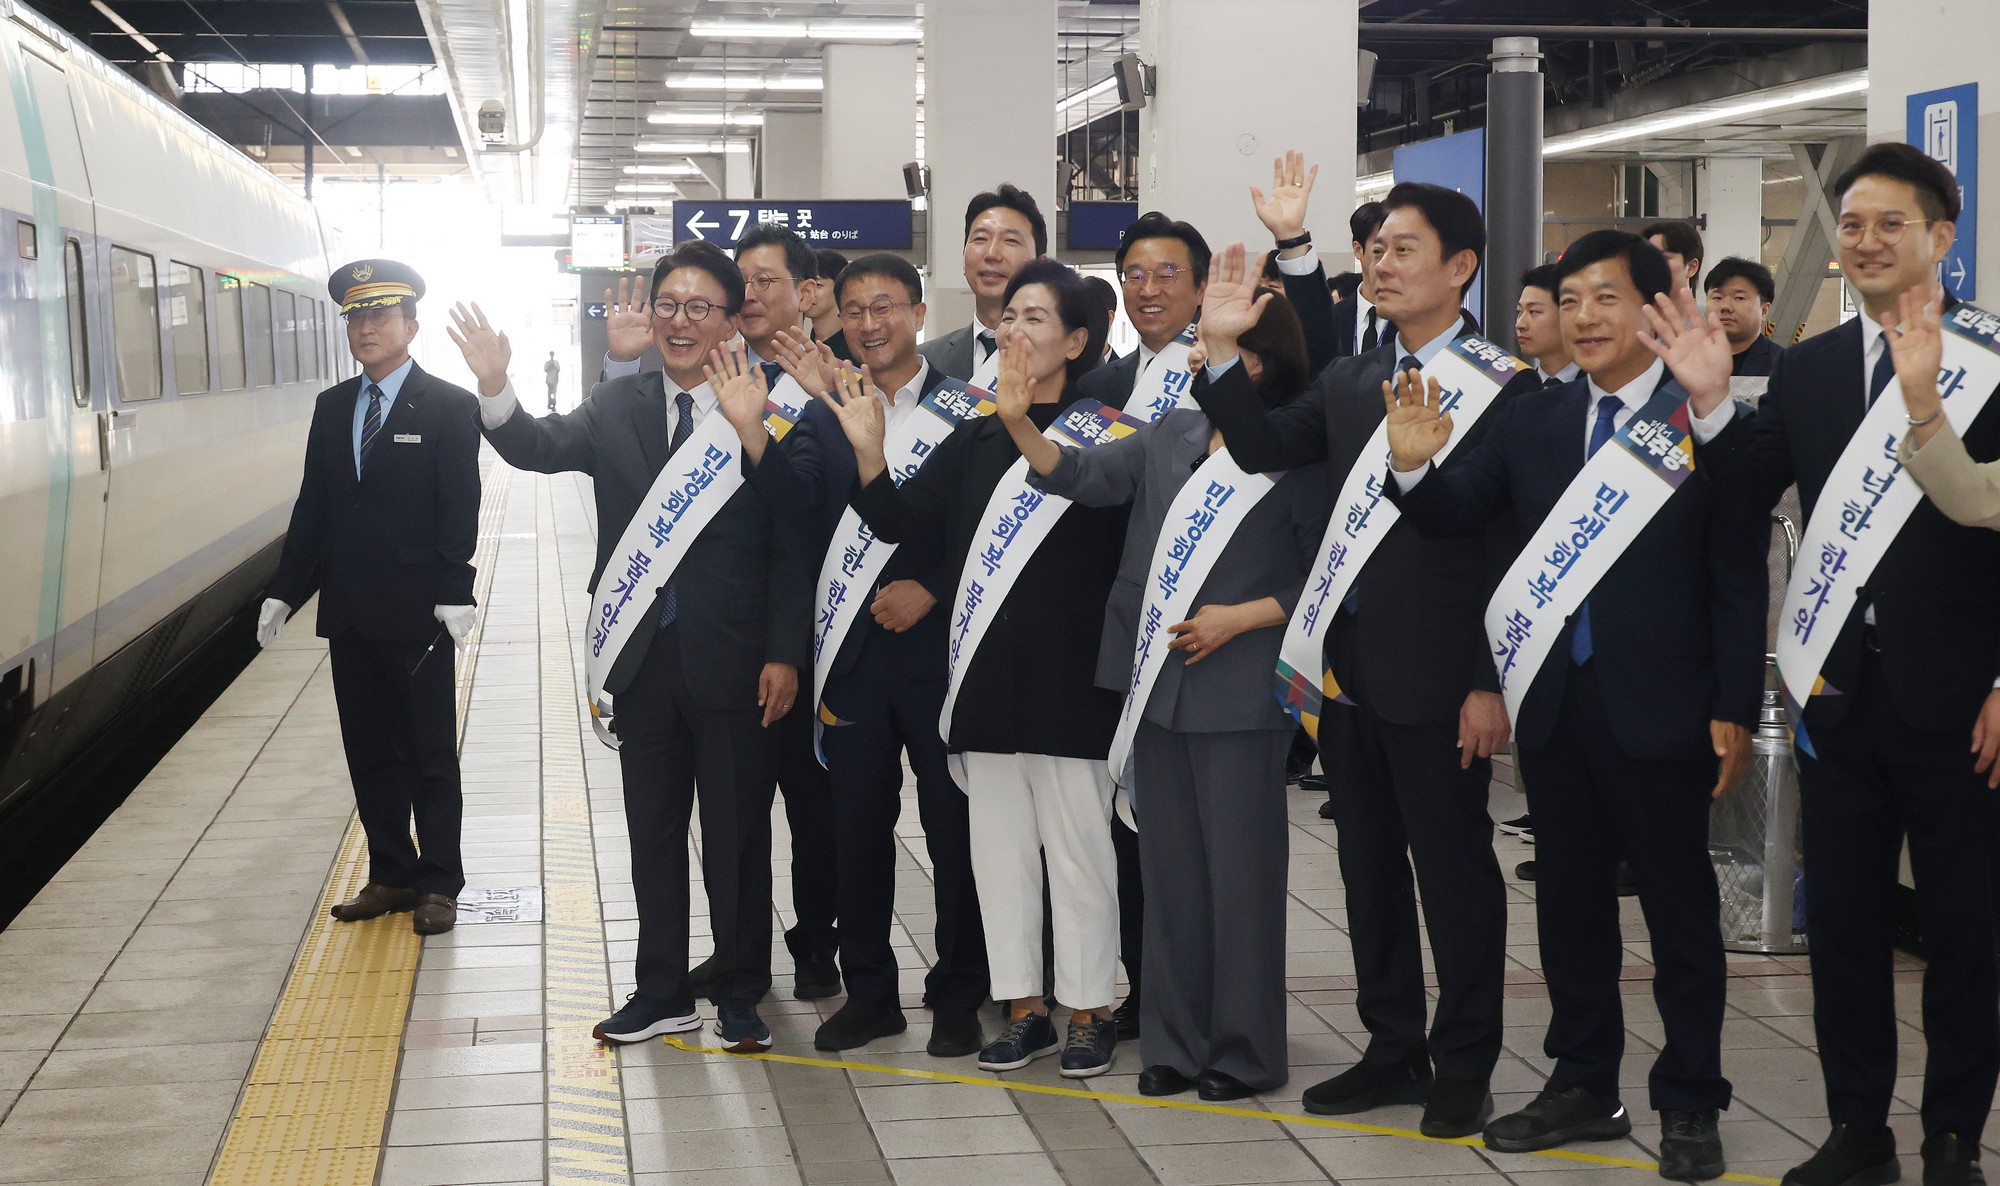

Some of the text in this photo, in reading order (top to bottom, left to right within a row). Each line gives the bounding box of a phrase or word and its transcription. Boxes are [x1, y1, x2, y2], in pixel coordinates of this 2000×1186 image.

[728, 210, 750, 241] 7
[797, 209, 813, 228] 곳
[810, 230, 829, 239] 站台
[832, 230, 859, 239] のりば
[1460, 338, 1517, 372] 민주당
[1626, 419, 1690, 472] 민주당
[592, 442, 732, 658] 민생회복 물가안정
[980, 486, 1048, 577] 생회복
[1158, 479, 1236, 600] 민생회복
[1302, 541, 1348, 637] 한가위
[1494, 481, 1631, 692] 민생회복 물가
[1792, 541, 1848, 646] 한가위
